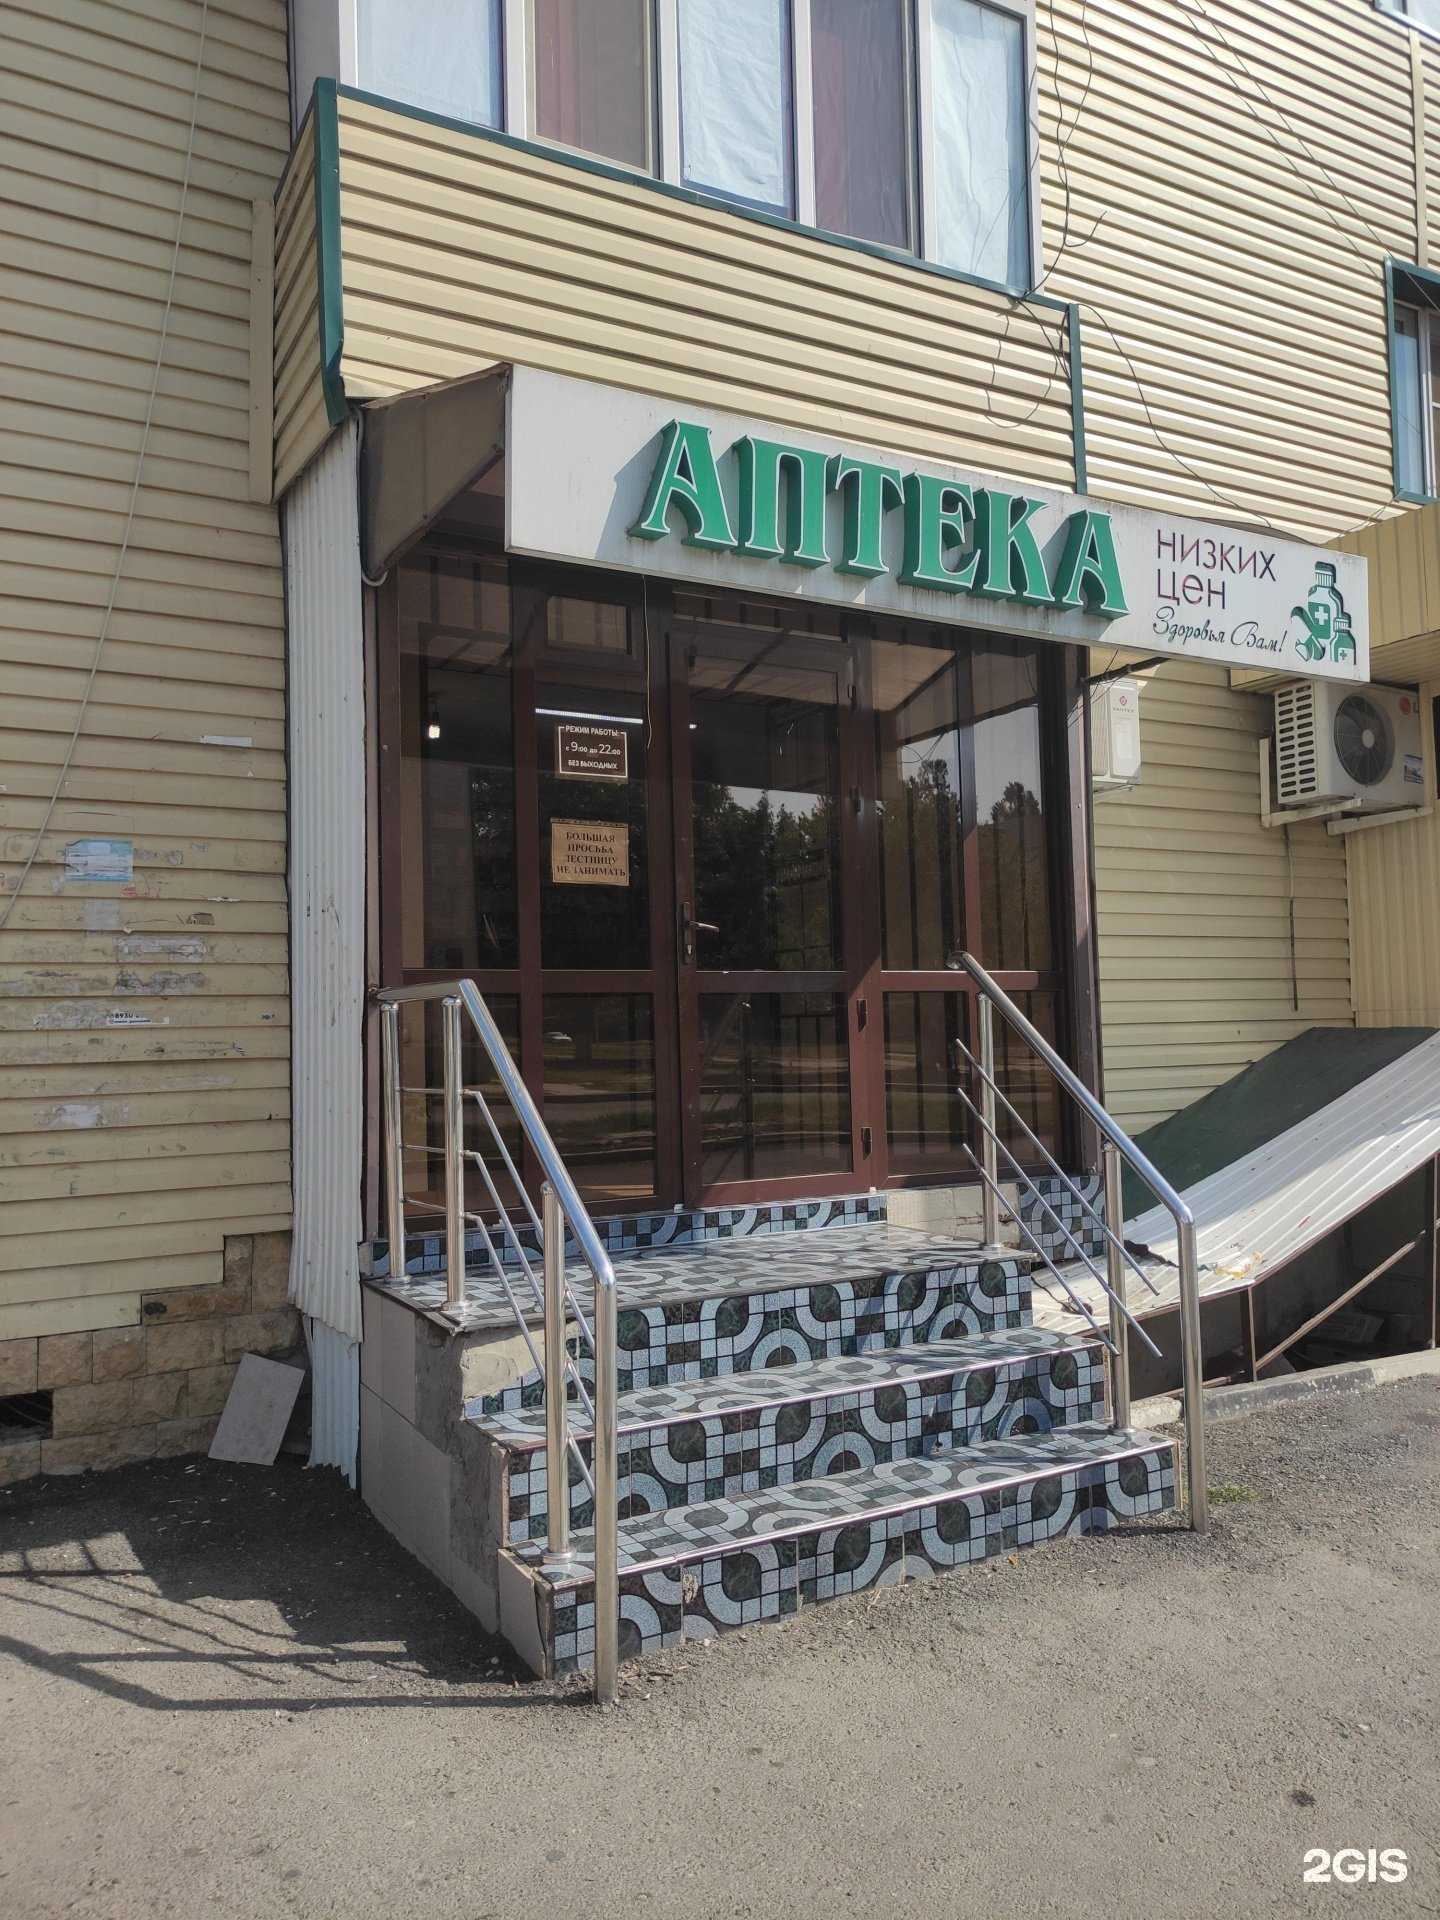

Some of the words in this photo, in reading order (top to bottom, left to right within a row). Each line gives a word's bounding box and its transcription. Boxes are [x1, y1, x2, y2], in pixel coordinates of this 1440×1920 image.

[628, 419, 1130, 619] АПТЕКА
[1157, 529, 1276, 582] НИЗКИХ
[1153, 605, 1225, 644] Здоровья
[1231, 621, 1288, 652] Вам!
[565, 725, 590, 734] РЕЖИМ
[568, 759, 580, 767] БЕЗ
[566, 832, 615, 843] БОЛЬШАЯ
[568, 844, 614, 854] ПРОСЬБА
[556, 865, 569, 874] НЕ
